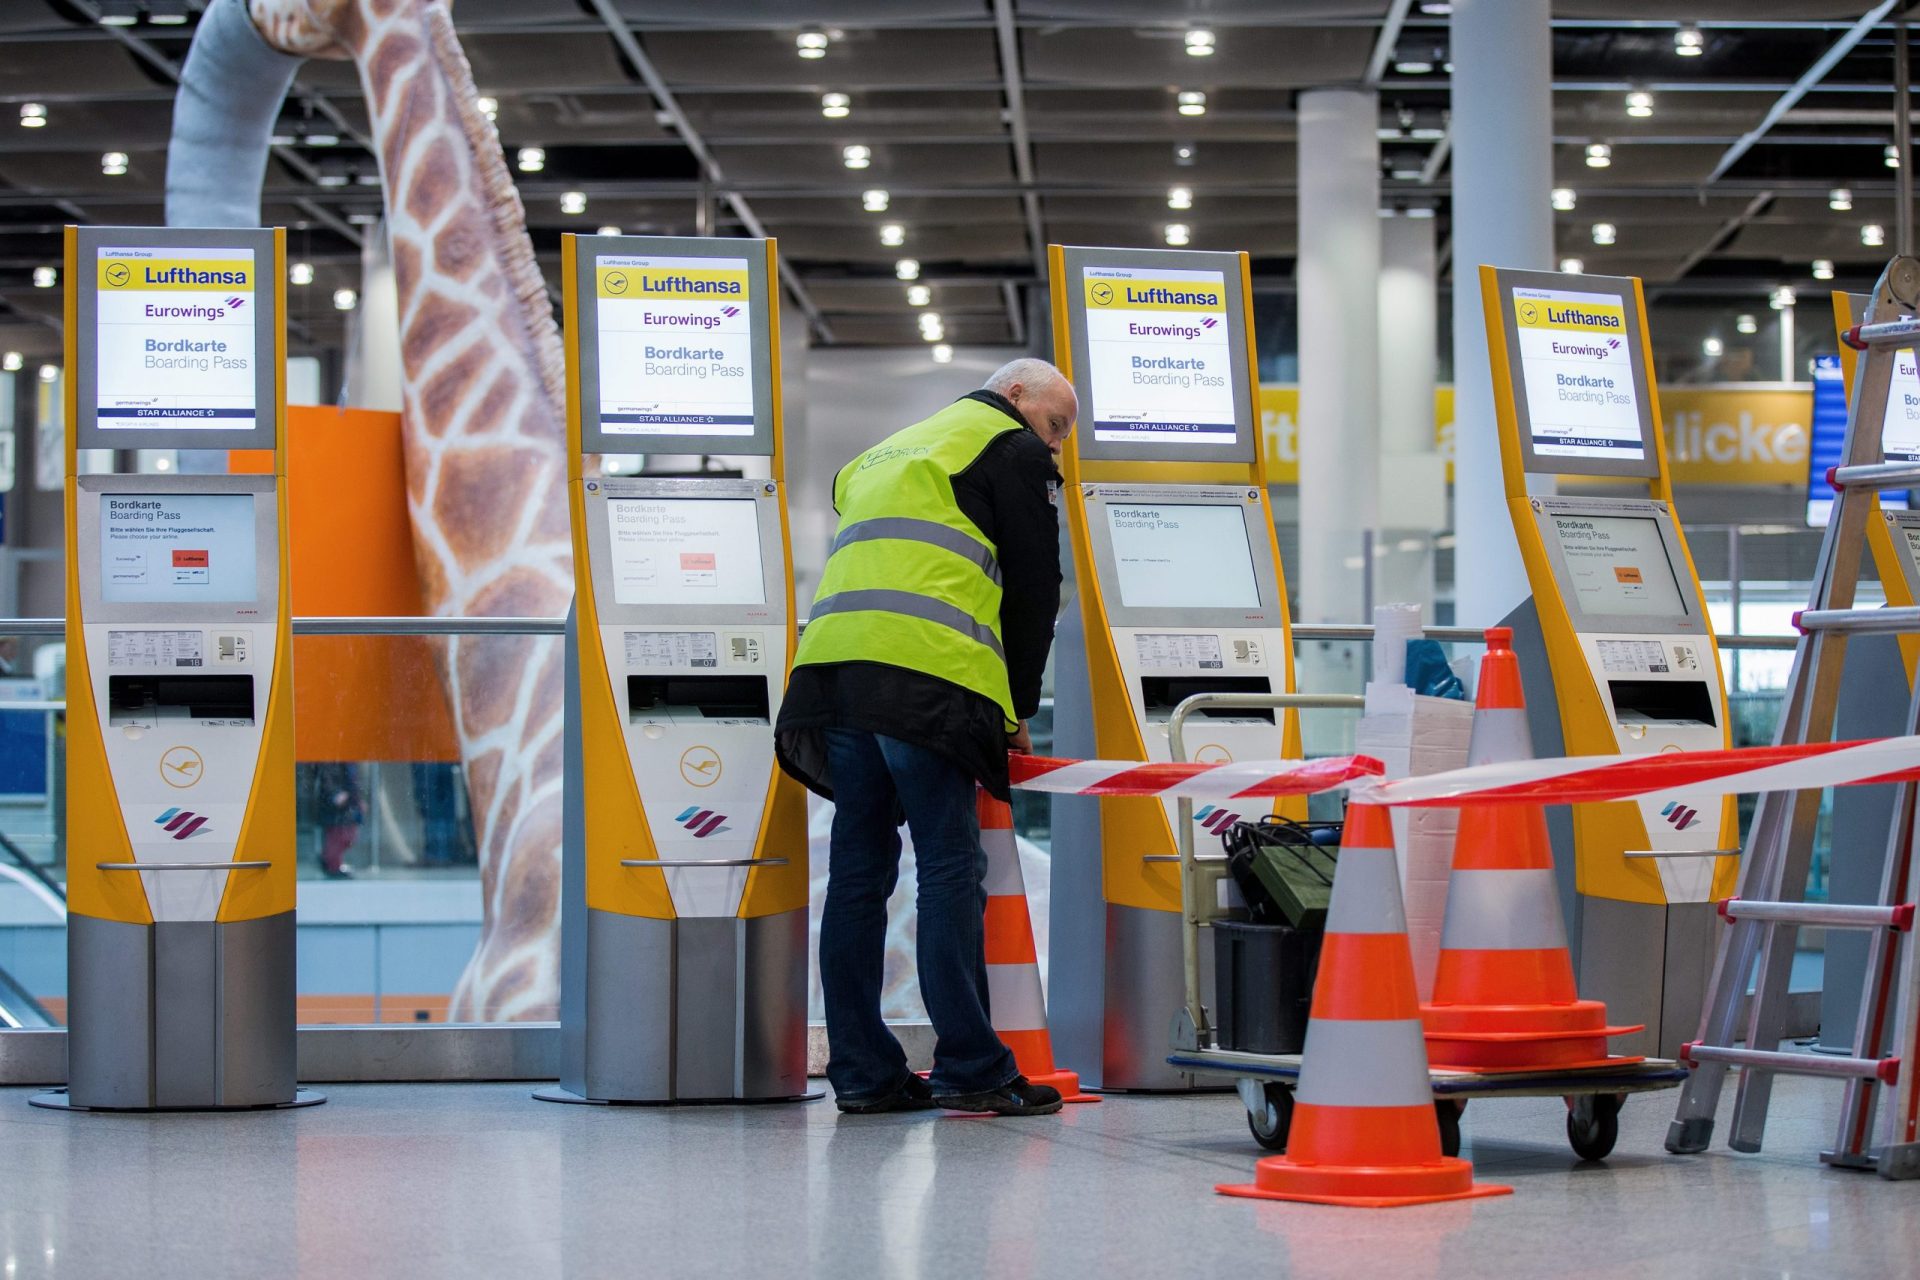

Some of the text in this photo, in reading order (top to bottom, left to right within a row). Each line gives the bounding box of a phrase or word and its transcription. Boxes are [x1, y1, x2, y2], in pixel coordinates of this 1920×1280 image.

[145, 267, 246, 284] Lufthansa
[643, 276, 741, 294] Lufthansa
[1127, 288, 1218, 305] Lufthansa
[145, 304, 225, 321] Eurowings
[1548, 308, 1619, 327] Lufthansa
[644, 312, 721, 329] Eurowings
[1130, 323, 1201, 339] Eurowings
[145, 339, 227, 352] Bordkarte
[1552, 342, 1608, 359] Eurowings
[645, 346, 724, 360] Bordkarte
[145, 356, 247, 371] Boarding Pass
[1132, 356, 1205, 370] Bordkarte
[645, 363, 744, 379] Boarding Pass
[1133, 372, 1225, 388] Boarding Pass
[1556, 374, 1614, 388] Bordkarte
[1558, 389, 1630, 405] Boarding Pass
[1577, 439, 1607, 447] ALLIANCE
[1666, 411, 1808, 464] licke
[110, 501, 161, 509] Bordkarte
[616, 504, 666, 513] Bordkarte
[110, 511, 180, 521] Boarding Pass
[617, 514, 686, 524] Boarding Pass
[1114, 510, 1160, 518] Bordkarte
[1115, 520, 1179, 529] Boarding Pass
[1556, 521, 1593, 529] Bordkarte
[1560, 530, 1610, 540] Boarding Pass
